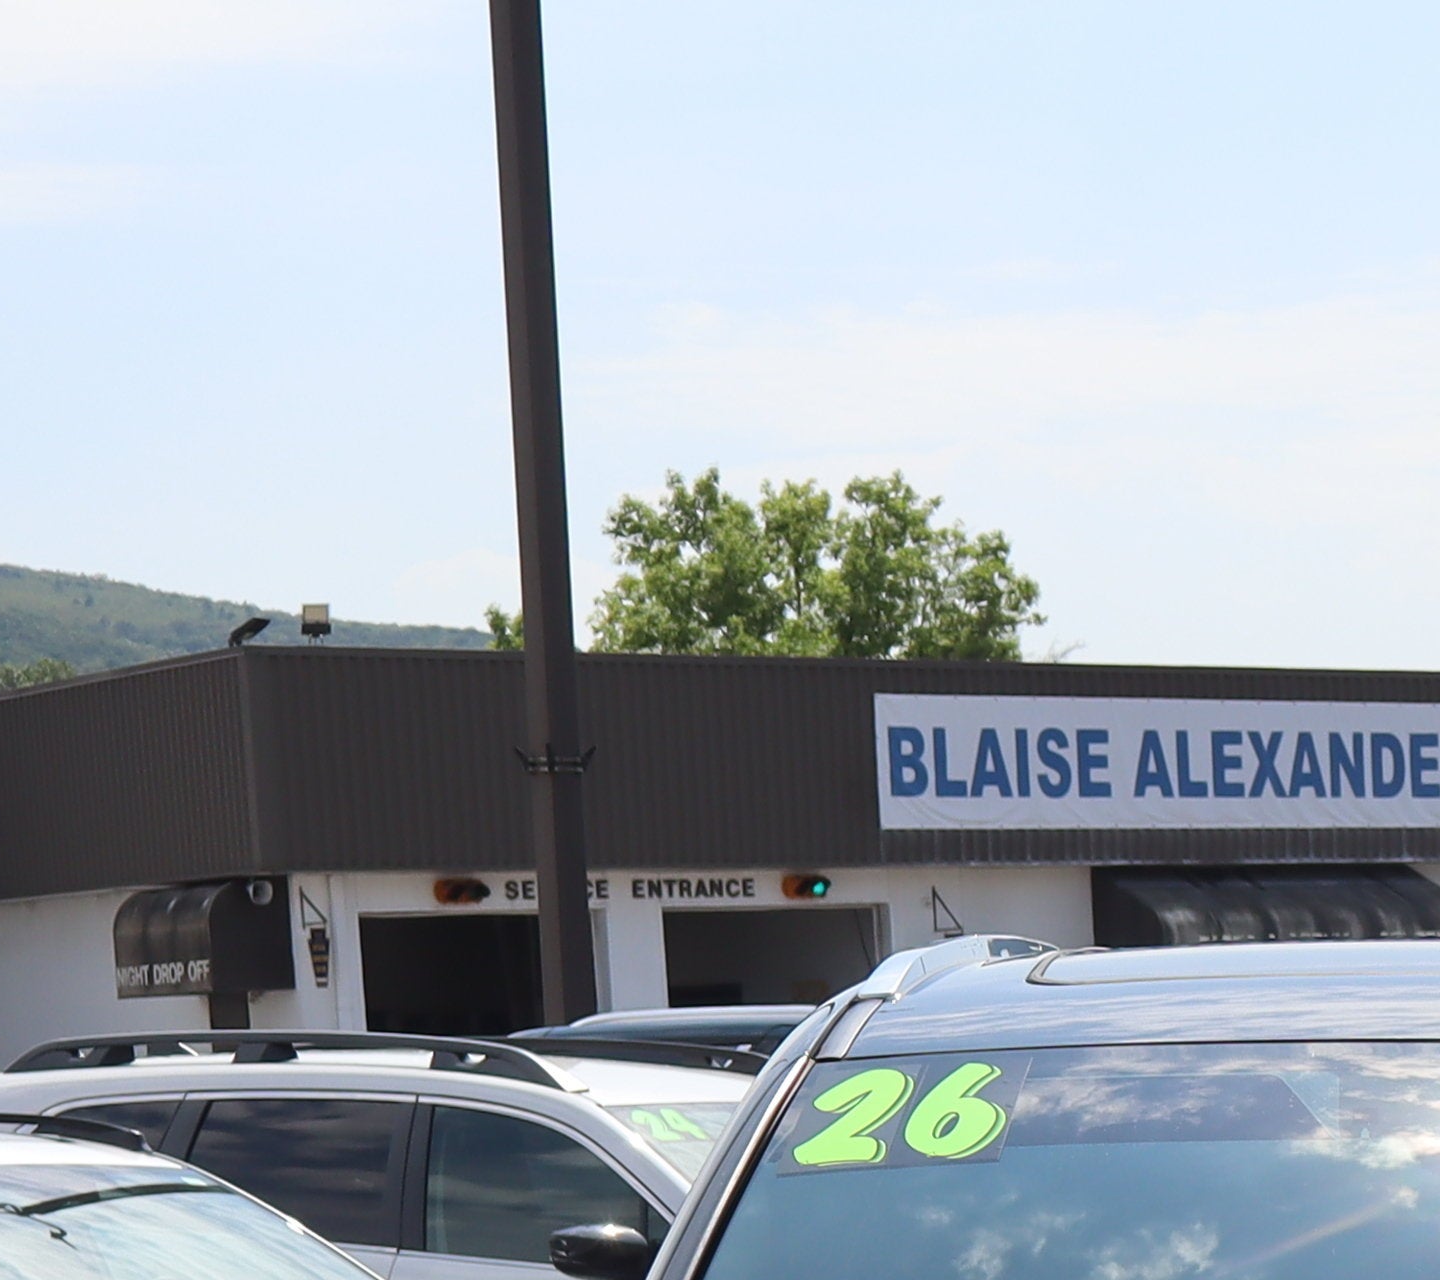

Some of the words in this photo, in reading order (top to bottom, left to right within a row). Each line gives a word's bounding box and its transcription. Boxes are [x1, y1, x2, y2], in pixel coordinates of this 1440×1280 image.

[887, 727, 1112, 799] BLAISE
[632, 878, 755, 899] ENTRANCE
[117, 964, 149, 987] NIGHT
[153, 961, 184, 986] DROP
[187, 959, 210, 982] OFF
[631, 1108, 710, 1141] 24
[793, 1061, 1007, 1167] 26
